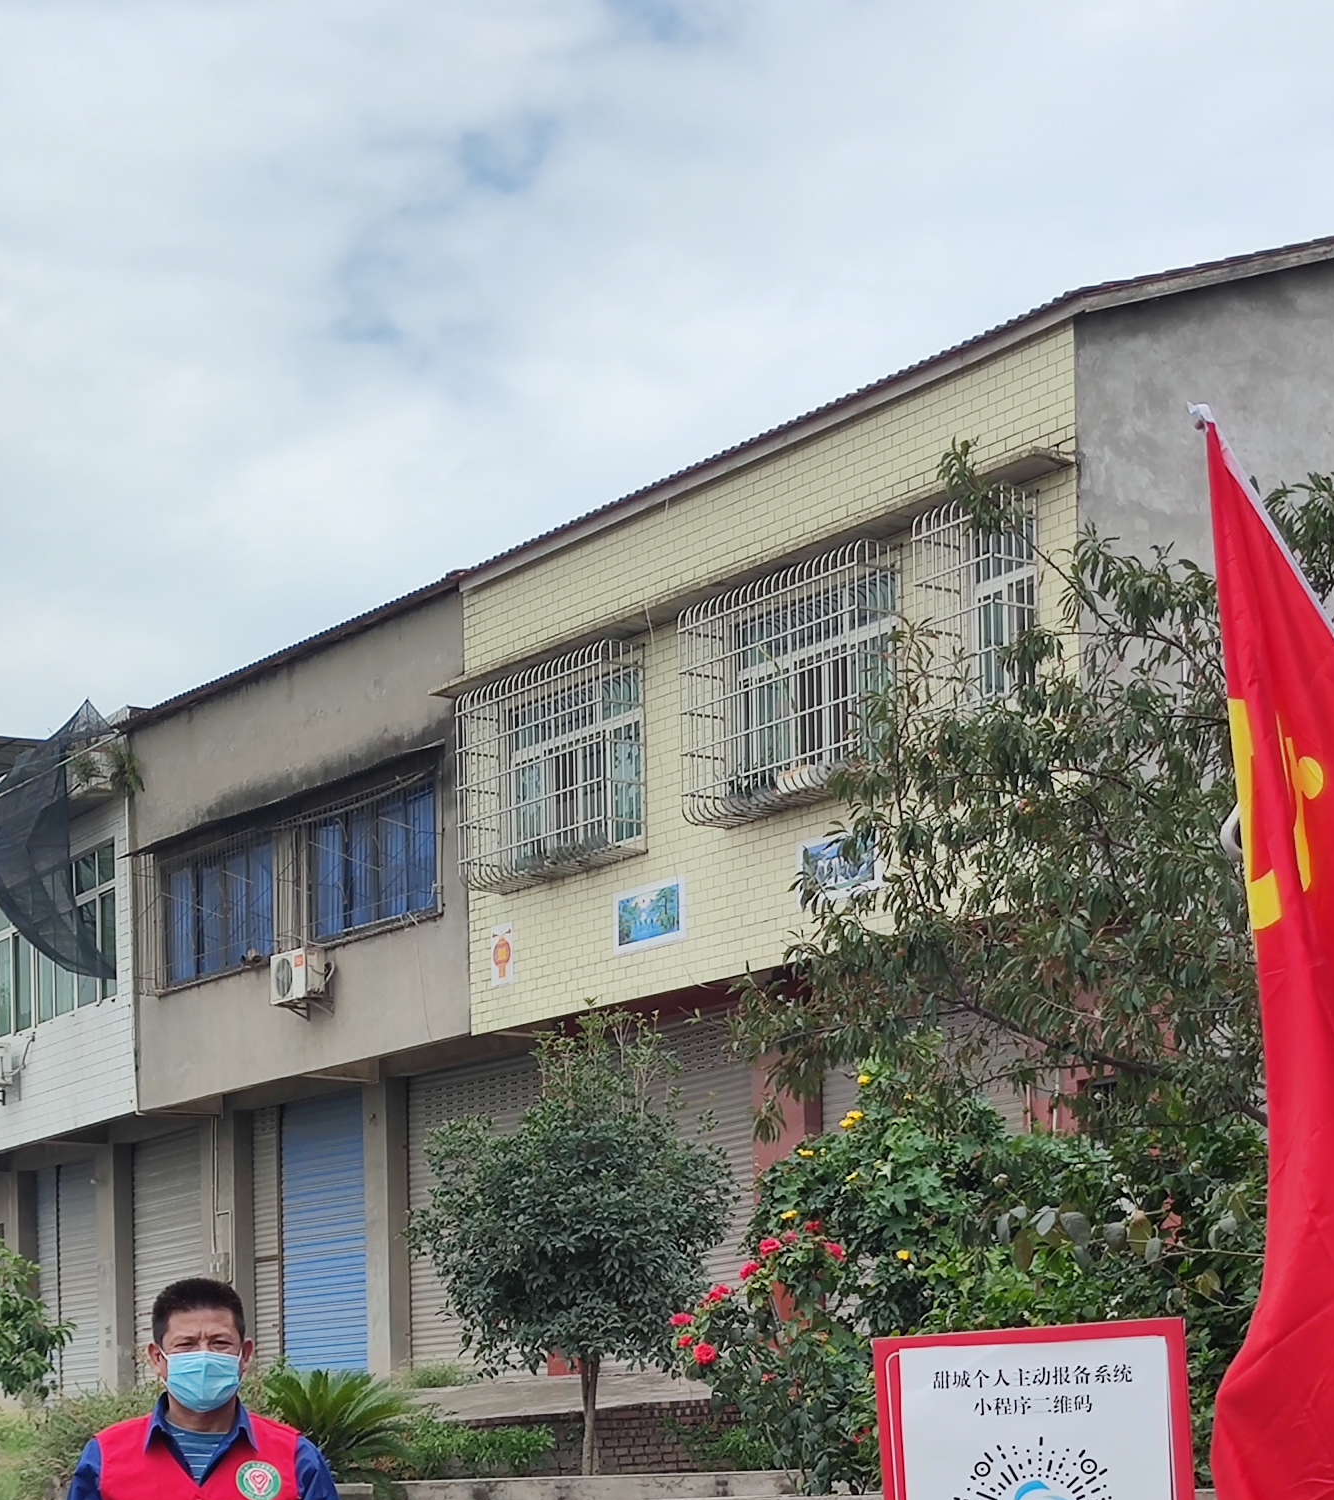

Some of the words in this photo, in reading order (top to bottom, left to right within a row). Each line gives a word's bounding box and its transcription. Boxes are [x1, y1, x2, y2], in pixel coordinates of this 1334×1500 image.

[932, 1364, 1133, 1390] 甜城个人主动报备系统
[973, 1394, 1093, 1416] 小程序二维码
